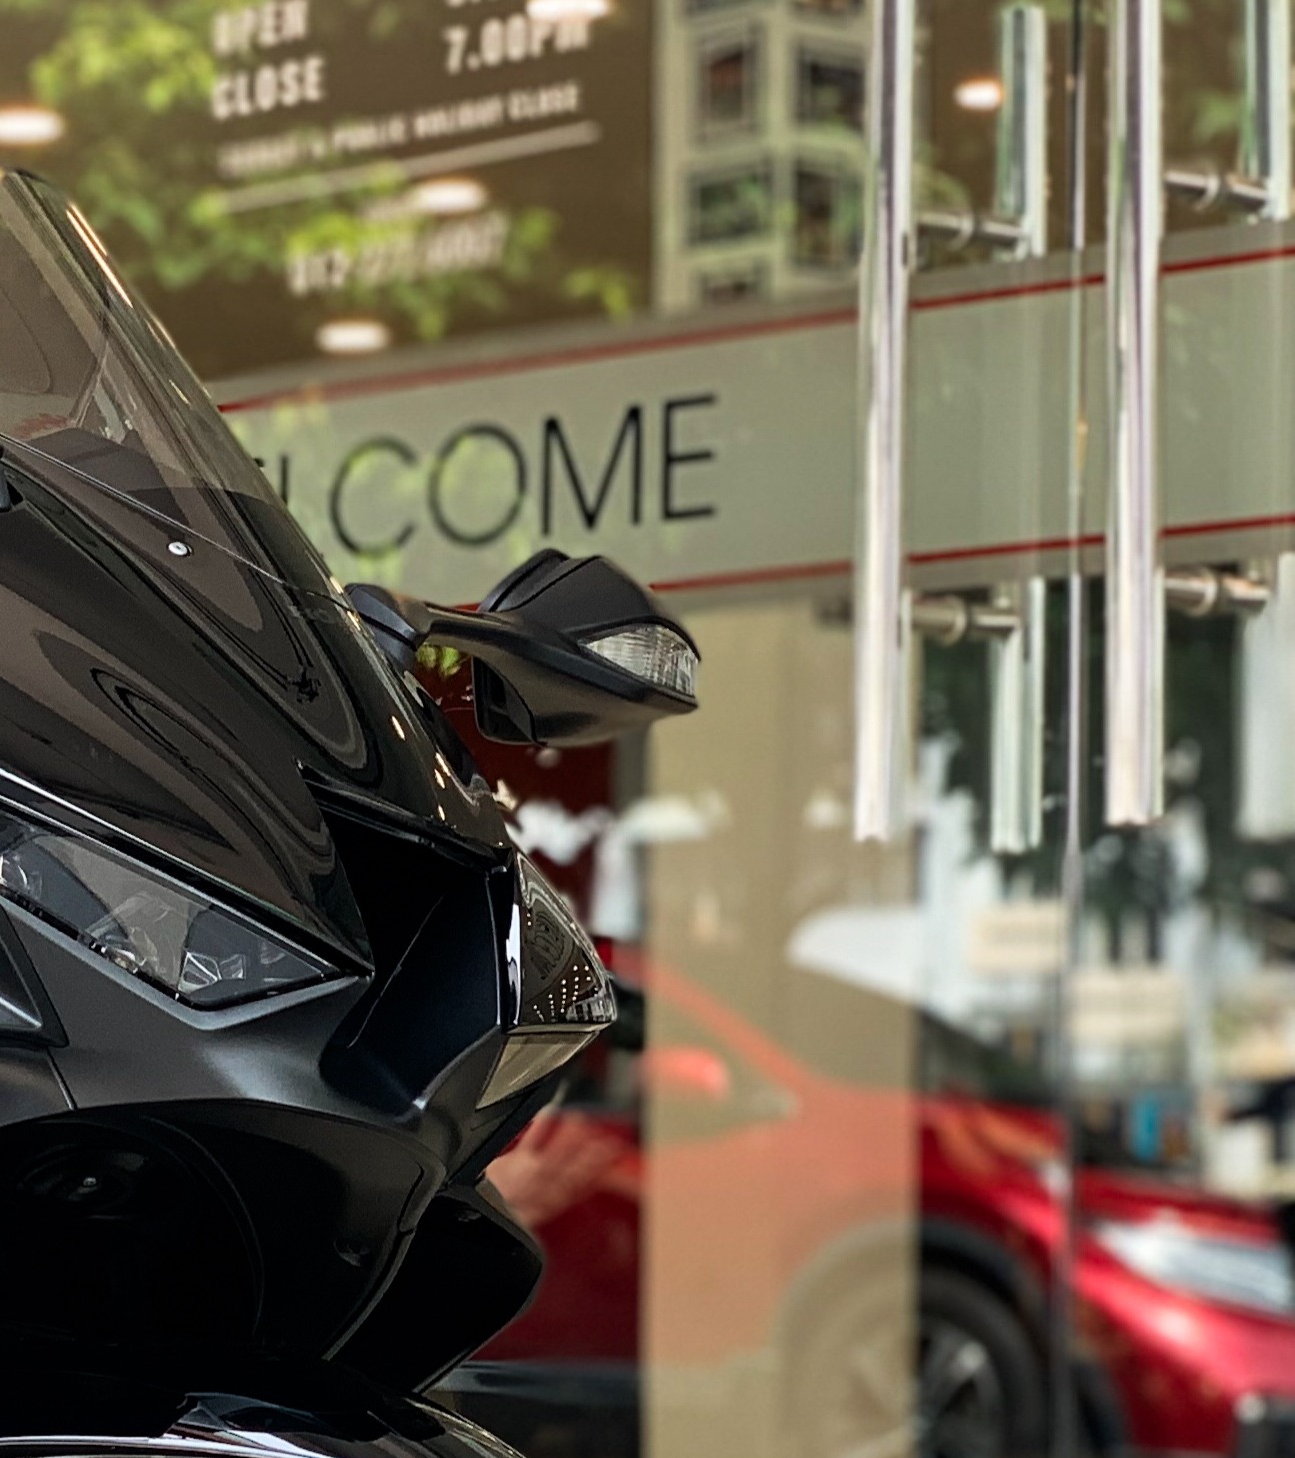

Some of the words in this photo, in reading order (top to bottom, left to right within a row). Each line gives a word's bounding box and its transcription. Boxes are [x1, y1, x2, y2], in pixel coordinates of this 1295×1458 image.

[213, 2, 308, 55] OPEN
[213, 57, 326, 120] CLOSE
[507, 82, 584, 122] CLOSE
